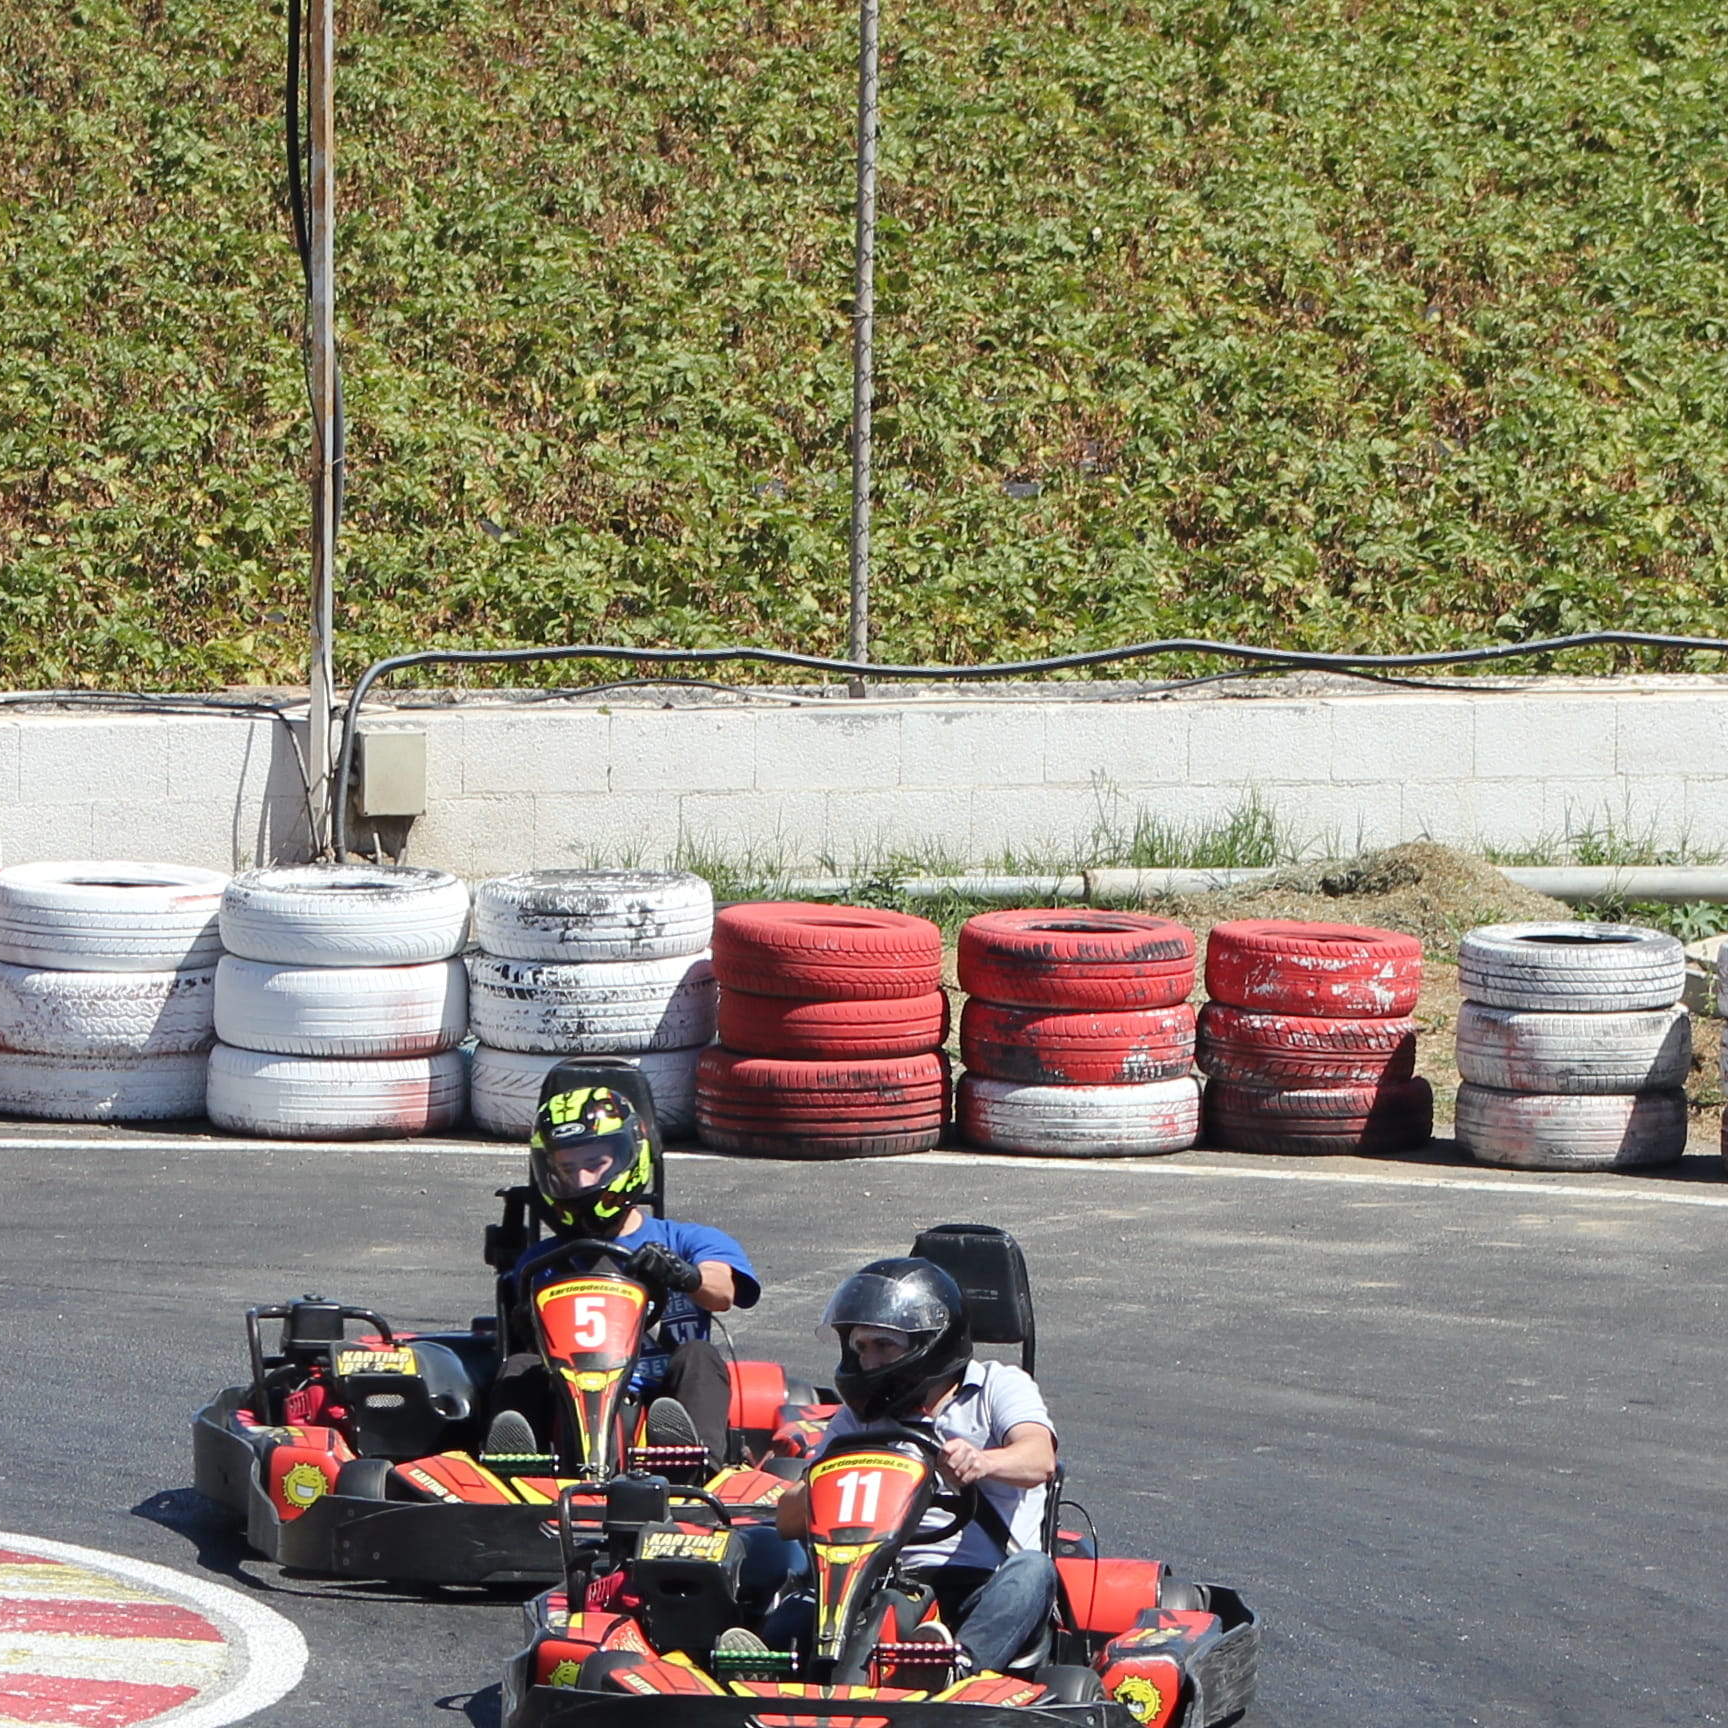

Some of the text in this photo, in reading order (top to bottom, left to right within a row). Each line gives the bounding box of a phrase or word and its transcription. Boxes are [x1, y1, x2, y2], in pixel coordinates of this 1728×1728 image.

[574, 1297, 607, 1348] 5
[342, 1350, 410, 1362] KARTING
[820, 1458, 910, 1473] kartingdelsol.es
[408, 1468, 449, 1497] KARTING
[836, 1471, 883, 1523] 11
[648, 1533, 724, 1548] KARTING
